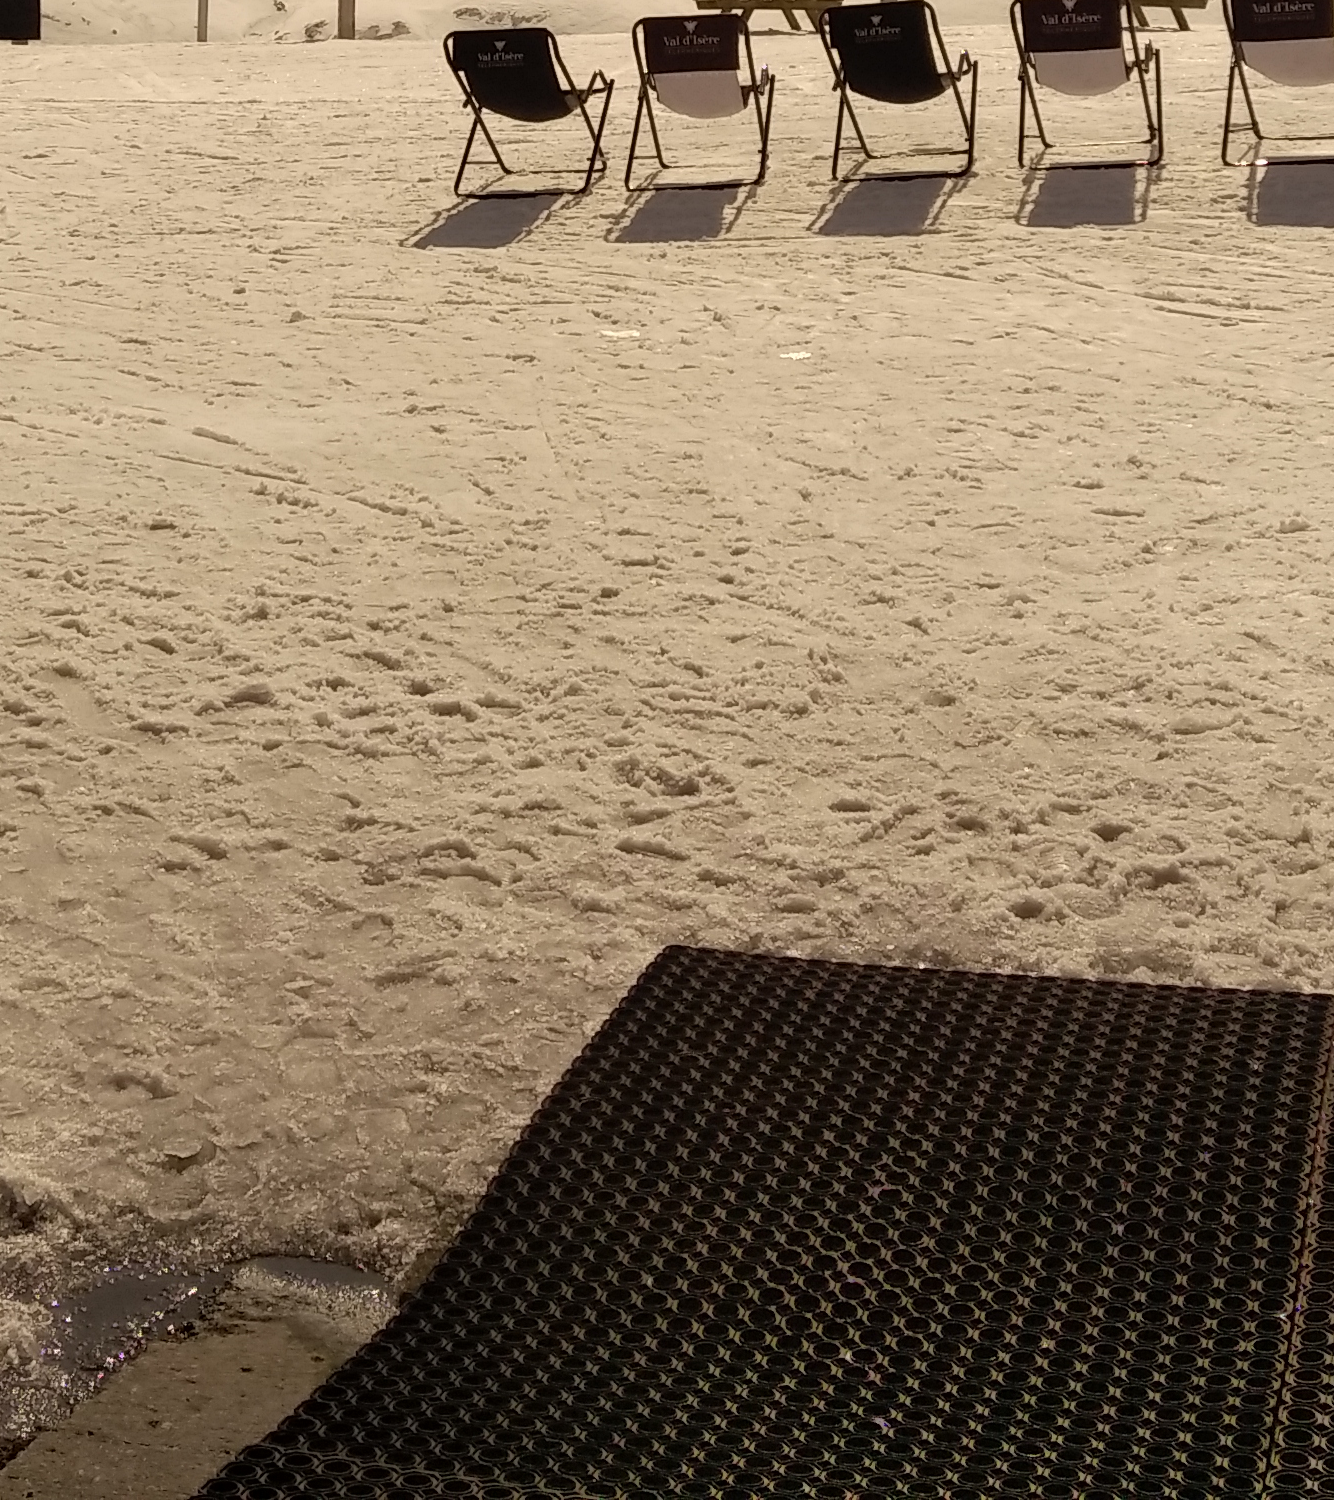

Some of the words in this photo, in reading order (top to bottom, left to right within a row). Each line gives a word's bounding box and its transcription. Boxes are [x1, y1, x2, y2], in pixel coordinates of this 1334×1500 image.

[1252, 2, 1271, 14] Val
[1273, 1, 1315, 12] d'Isère
[1041, 14, 1059, 25] Val
[1061, 12, 1102, 24] d'Isère
[854, 28, 868, 37] Val
[870, 26, 901, 36] d'Isère
[663, 35, 680, 46] Val
[683, 34, 720, 46] d'Isère
[478, 52, 491, 61] Val
[493, 51, 524, 61] d'Isère
